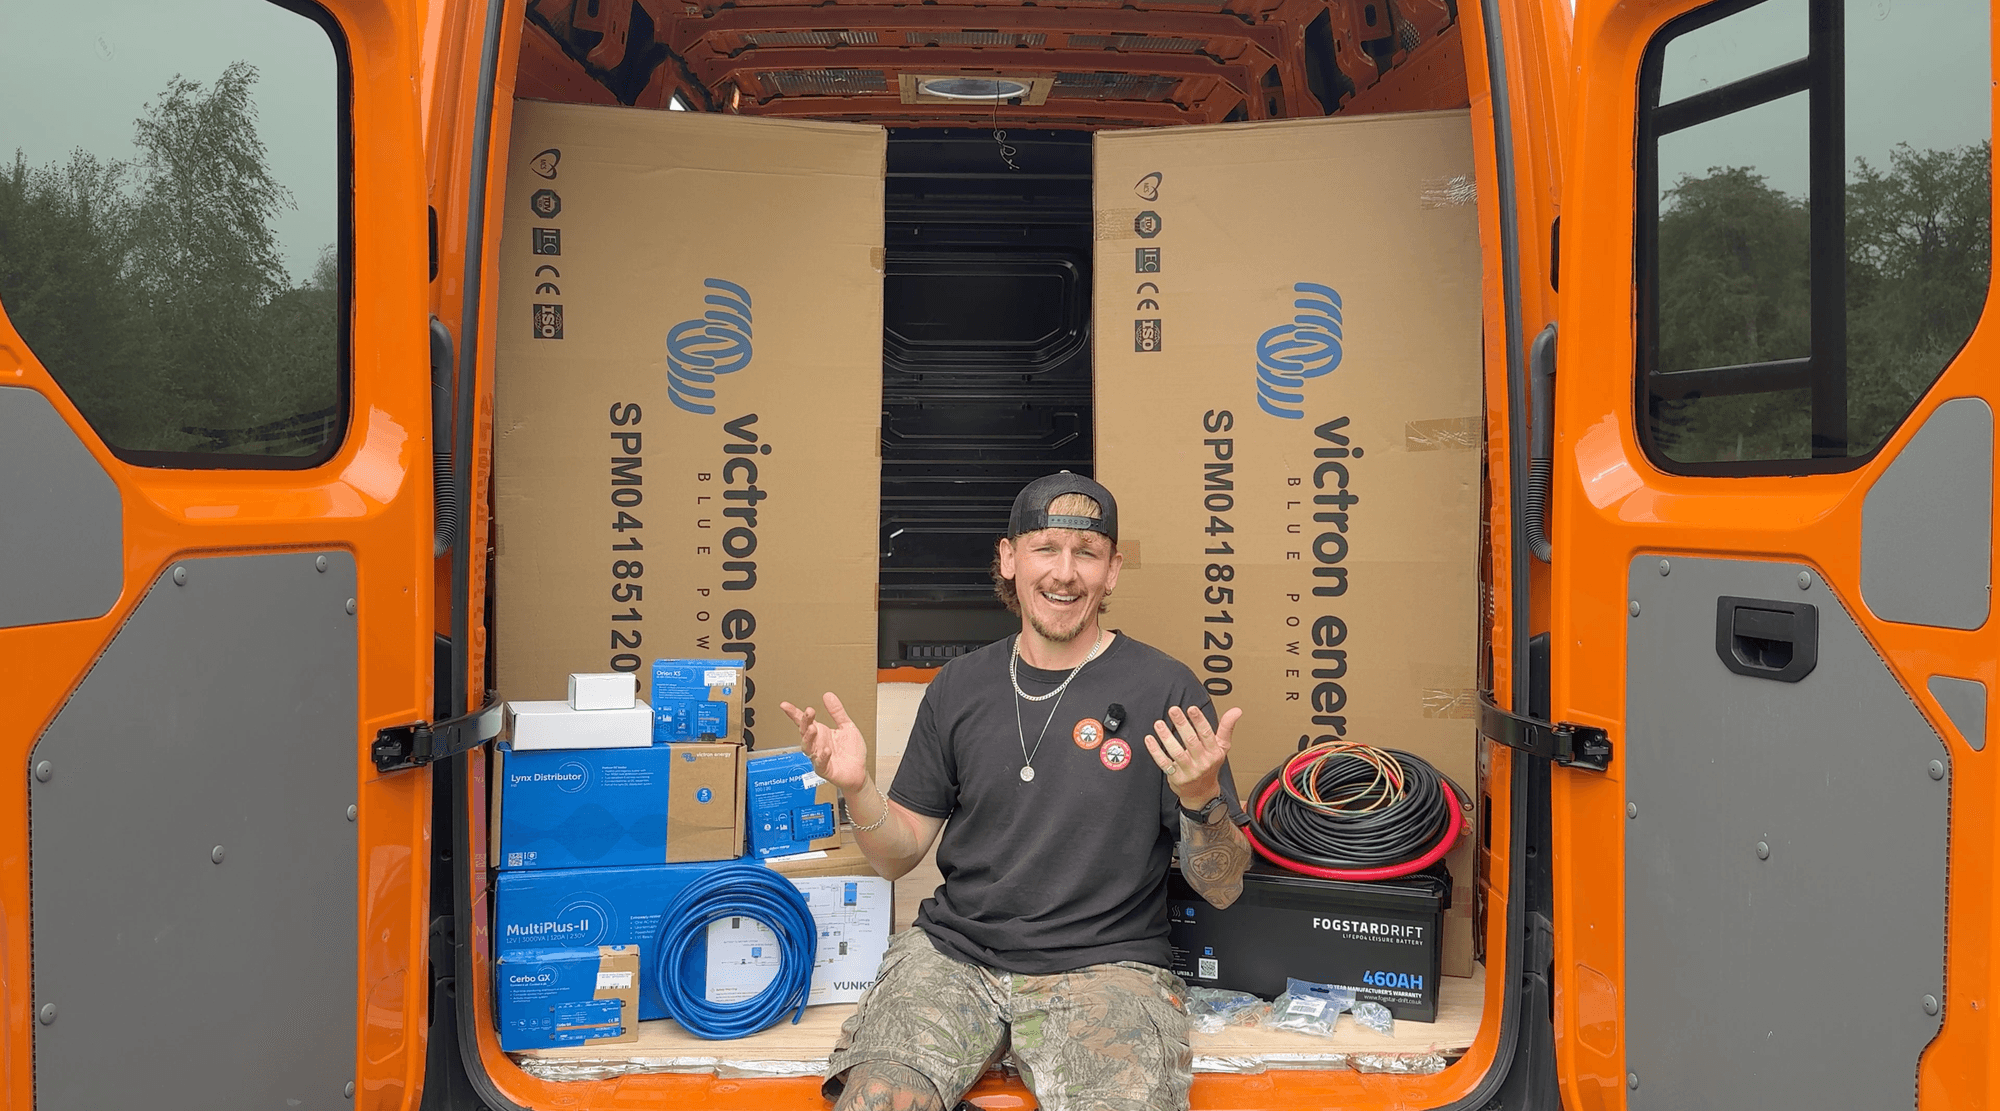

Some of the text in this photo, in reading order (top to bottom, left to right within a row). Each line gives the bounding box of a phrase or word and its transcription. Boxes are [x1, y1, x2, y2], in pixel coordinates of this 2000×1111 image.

[543, 229, 558, 254] IEC
[1144, 248, 1158, 272] IEC
[535, 265, 560, 296] CE
[1136, 281, 1160, 311] CE
[541, 305, 556, 338] ISO
[1142, 320, 1154, 351] ISO
[697, 472, 711, 555] BLUE
[722, 413, 773, 591] victron
[1312, 416, 1365, 597] victron
[609, 401, 644, 693] SPM04185120
[1202, 409, 1235, 696] SPM041851200
[1285, 477, 1301, 701] BLUE POWER
[511, 772, 582, 784] Lynx Distributor
[754, 777, 788, 788] SmartSolar
[506, 919, 589, 936] MultiPlus-II
[522, 935, 546, 943] 3000VA
[569, 932, 586, 940] 230V
[1313, 917, 1424, 939] FOGSTARDRIFT
[1368, 935, 1394, 944] LEISURE
[1395, 938, 1424, 946] BATTERY
[509, 973, 551, 983] Cerbo GX
[1362, 970, 1423, 990] 460AH
[1347, 985, 1393, 997] MANUFACTURER'S
[1393, 990, 1422, 998] WARRANTY
